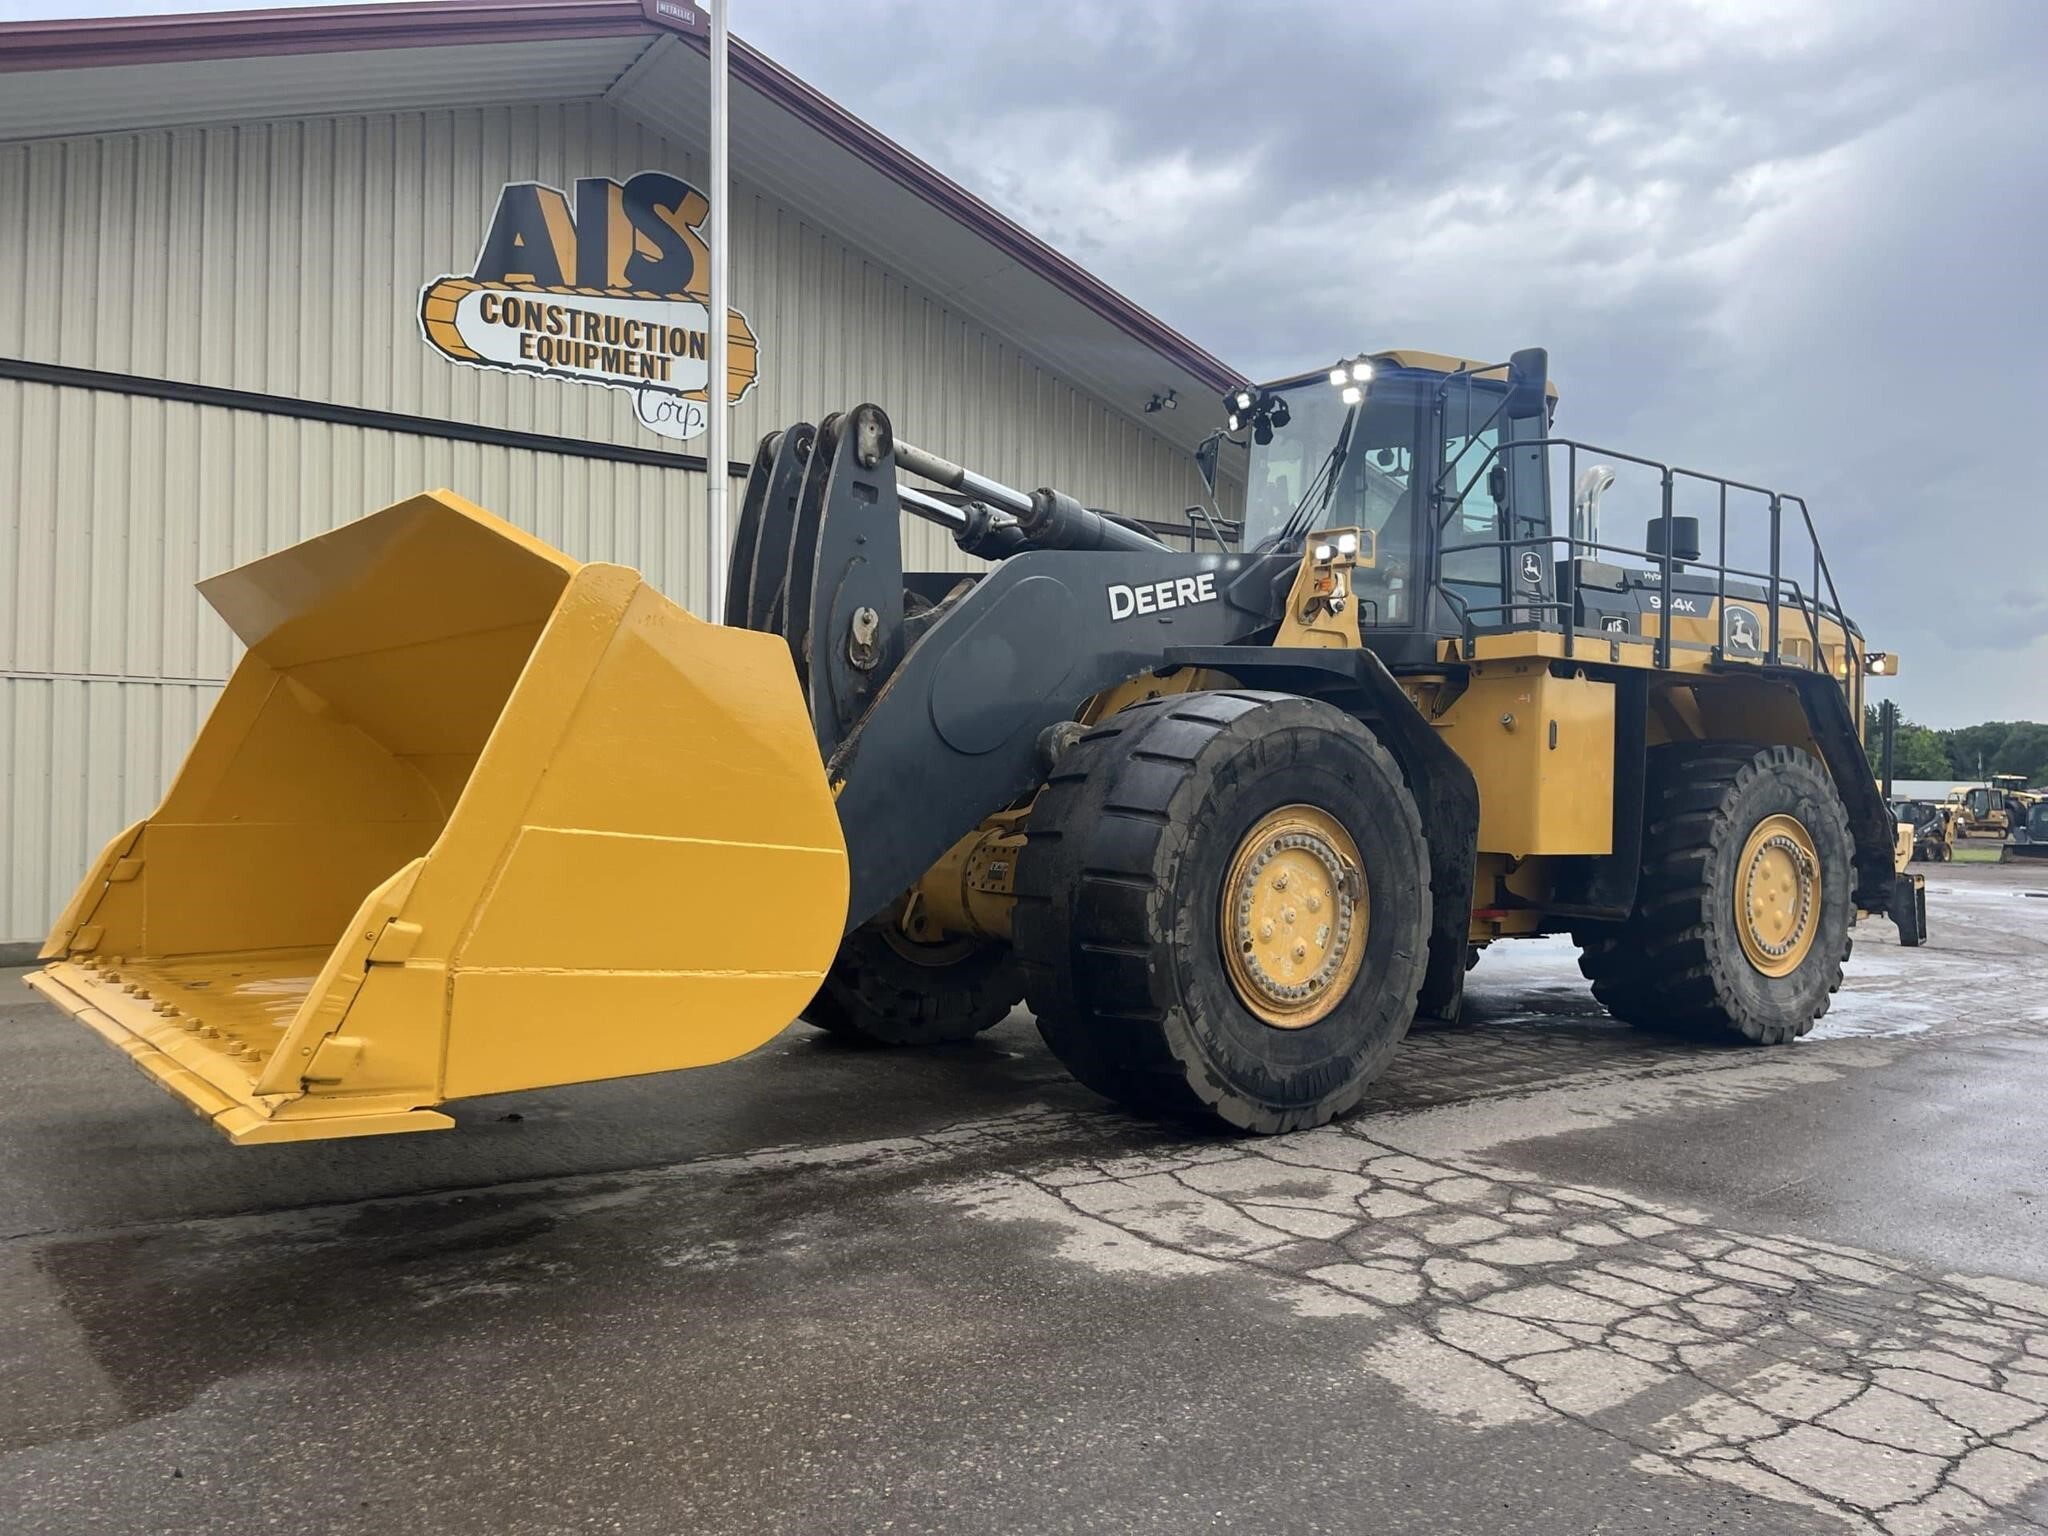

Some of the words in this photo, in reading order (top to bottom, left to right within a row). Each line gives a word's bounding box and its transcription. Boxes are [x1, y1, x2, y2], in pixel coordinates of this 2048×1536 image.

[660, 3, 691, 20] METALLIC
[474, 172, 709, 291] AIS
[480, 292, 708, 361] CONSTRUCTION
[519, 332, 672, 382] EQUIPMENT
[638, 379, 704, 436] Corp.
[1108, 572, 1217, 620] DEERE
[1649, 595, 1696, 612] 94K
